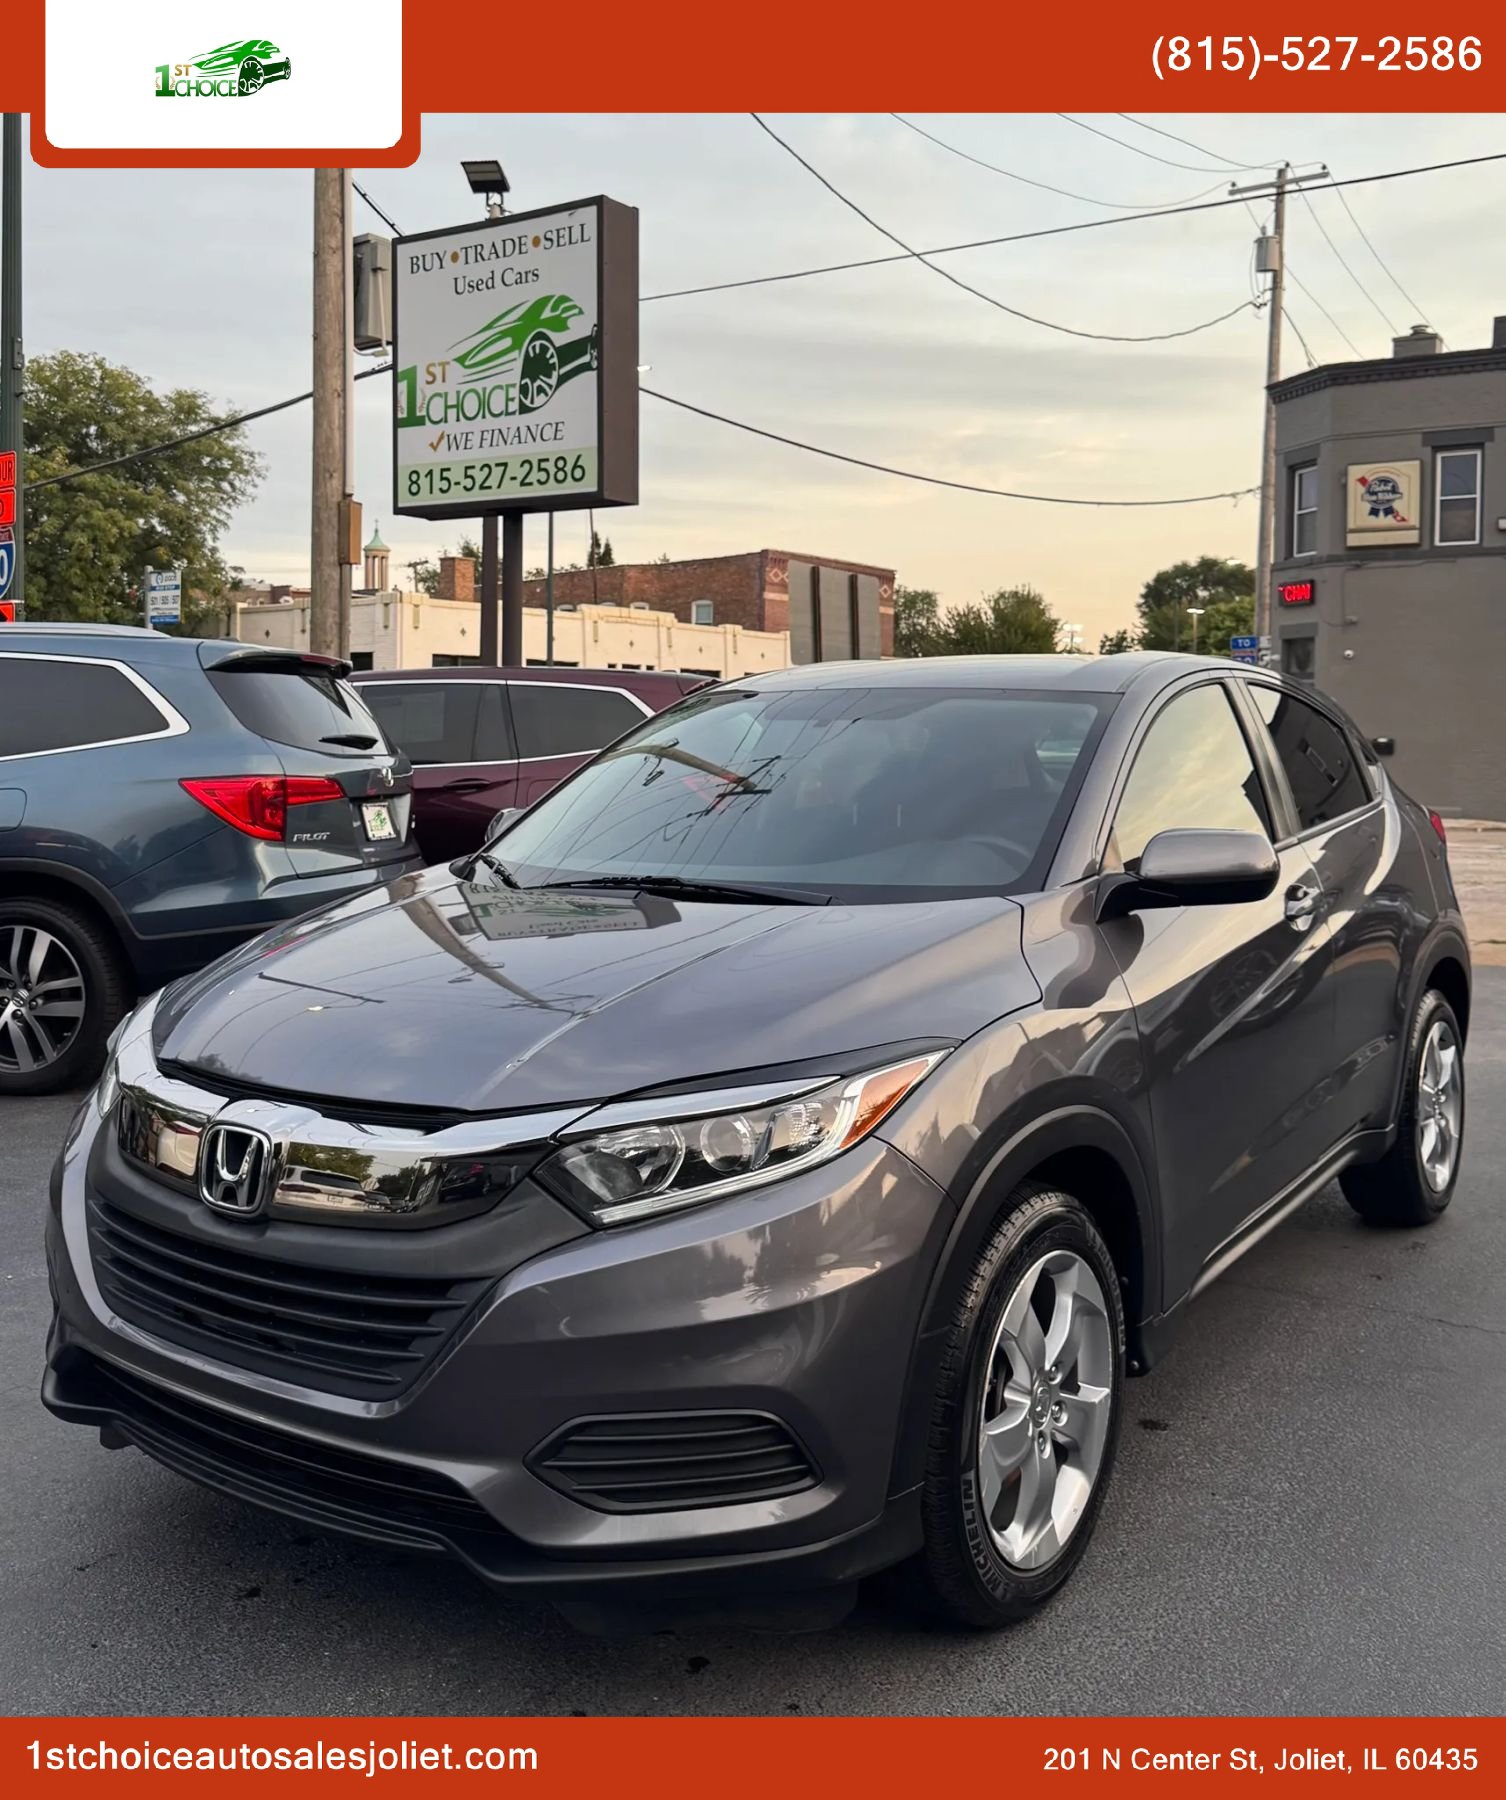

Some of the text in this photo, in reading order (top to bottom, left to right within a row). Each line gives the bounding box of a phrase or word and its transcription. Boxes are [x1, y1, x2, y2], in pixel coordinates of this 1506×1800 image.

[409, 223, 591, 275] BUY TRADE SELL
[453, 267, 540, 296] Used Cars
[425, 361, 450, 385] ST
[425, 383, 518, 426] CHOICE
[446, 421, 566, 452] WE FINANCE
[407, 454, 586, 497] 815-527-2586
[292, 831, 331, 842] PILOT
[962, 1479, 1002, 1594] MICHELIN
